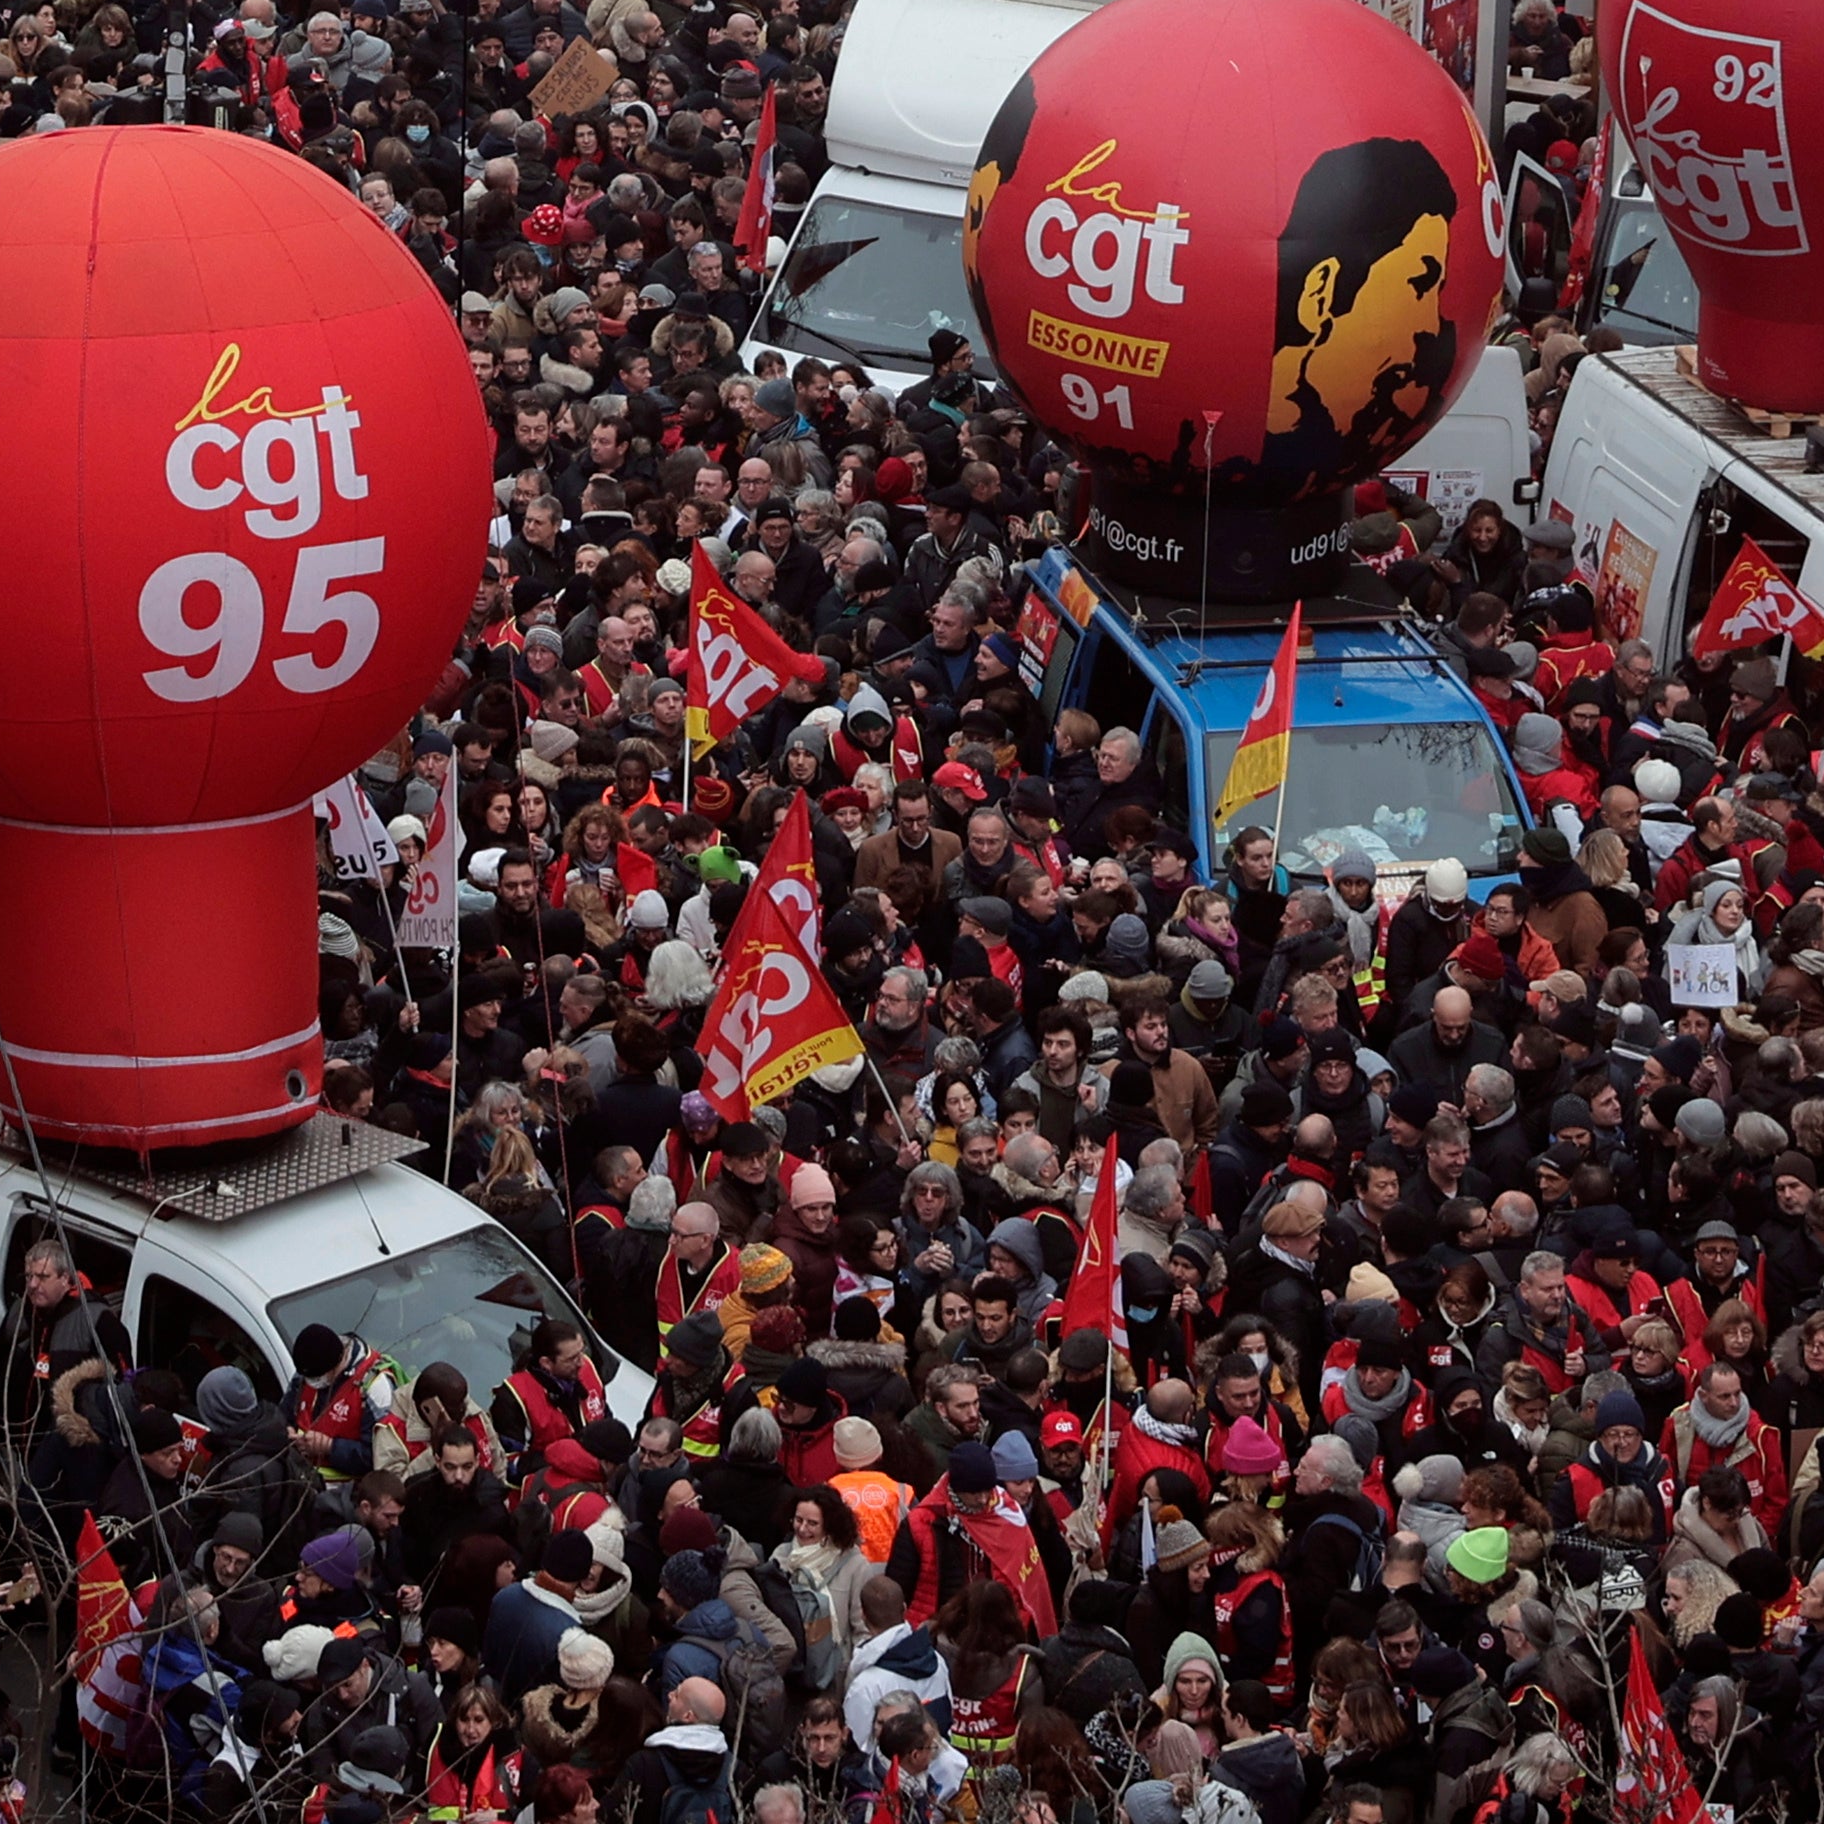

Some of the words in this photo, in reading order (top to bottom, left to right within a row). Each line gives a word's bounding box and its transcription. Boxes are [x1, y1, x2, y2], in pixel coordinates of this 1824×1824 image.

[535, 84, 556, 107] LES
[569, 79, 600, 110] NOUS
[1712, 54, 1779, 108] 92
[1044, 138, 1191, 222] la
[1633, 136, 1804, 244] cgt
[1024, 196, 1191, 319] cgt
[1031, 317, 1162, 371] ESSONNE
[174, 342, 353, 431] la
[1059, 373, 1136, 431] 91
[165, 385, 369, 540] cgt
[137, 536, 386, 704] 95
